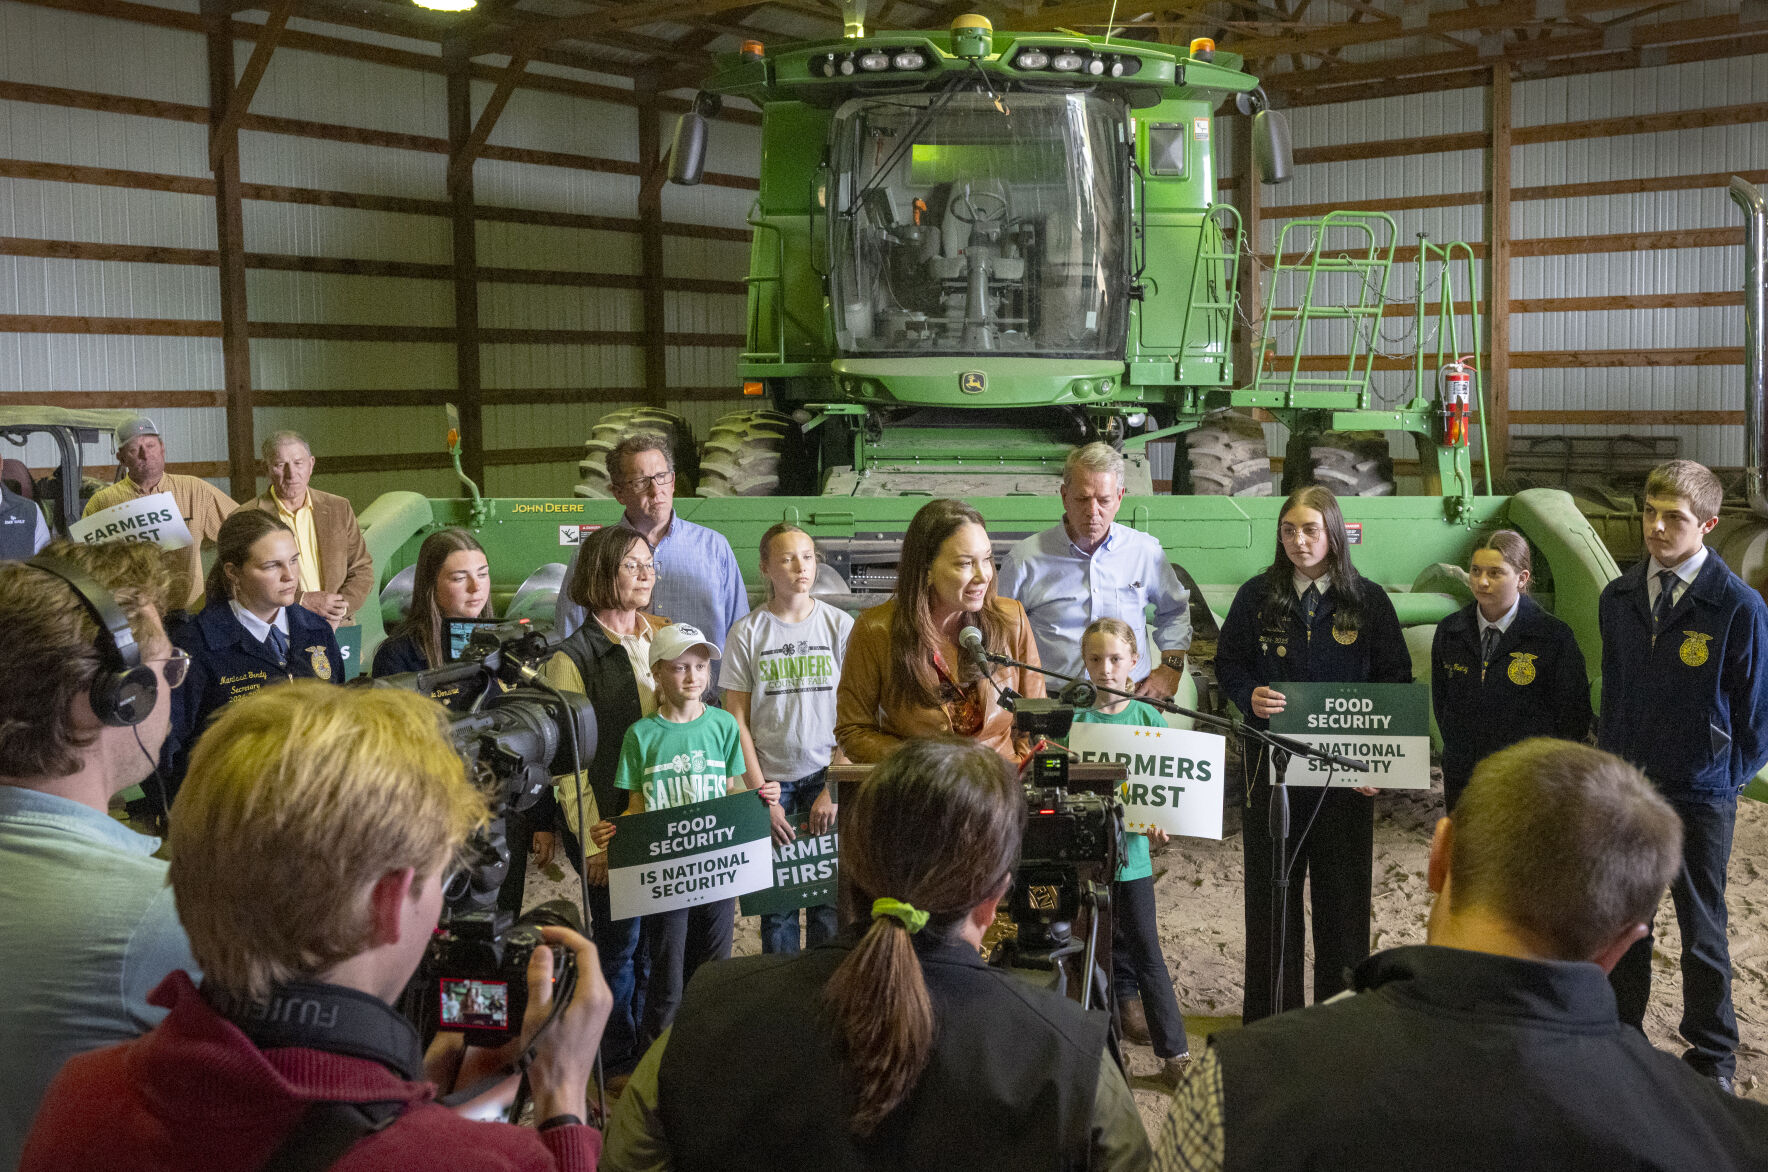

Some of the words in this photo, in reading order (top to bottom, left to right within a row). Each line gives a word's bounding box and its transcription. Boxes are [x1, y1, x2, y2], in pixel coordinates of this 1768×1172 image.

[512, 503, 544, 513] JOHN
[545, 502, 585, 513] DEERE
[83, 509, 173, 543] FARMERS
[123, 528, 160, 542] RST
[759, 655, 833, 682] SAUNDERS
[768, 678, 805, 689] COUNTY
[807, 676, 829, 686] FAIR
[1325, 698, 1374, 712] FOOD
[1307, 713, 1392, 729] SECURITY
[1319, 742, 1406, 757] NATIONAL
[667, 814, 717, 837] FOOD
[649, 825, 736, 856] SECURITY
[640, 870, 658, 886] IS
[662, 851, 750, 882] NATIONAL
[651, 869, 737, 899] SECURITY
